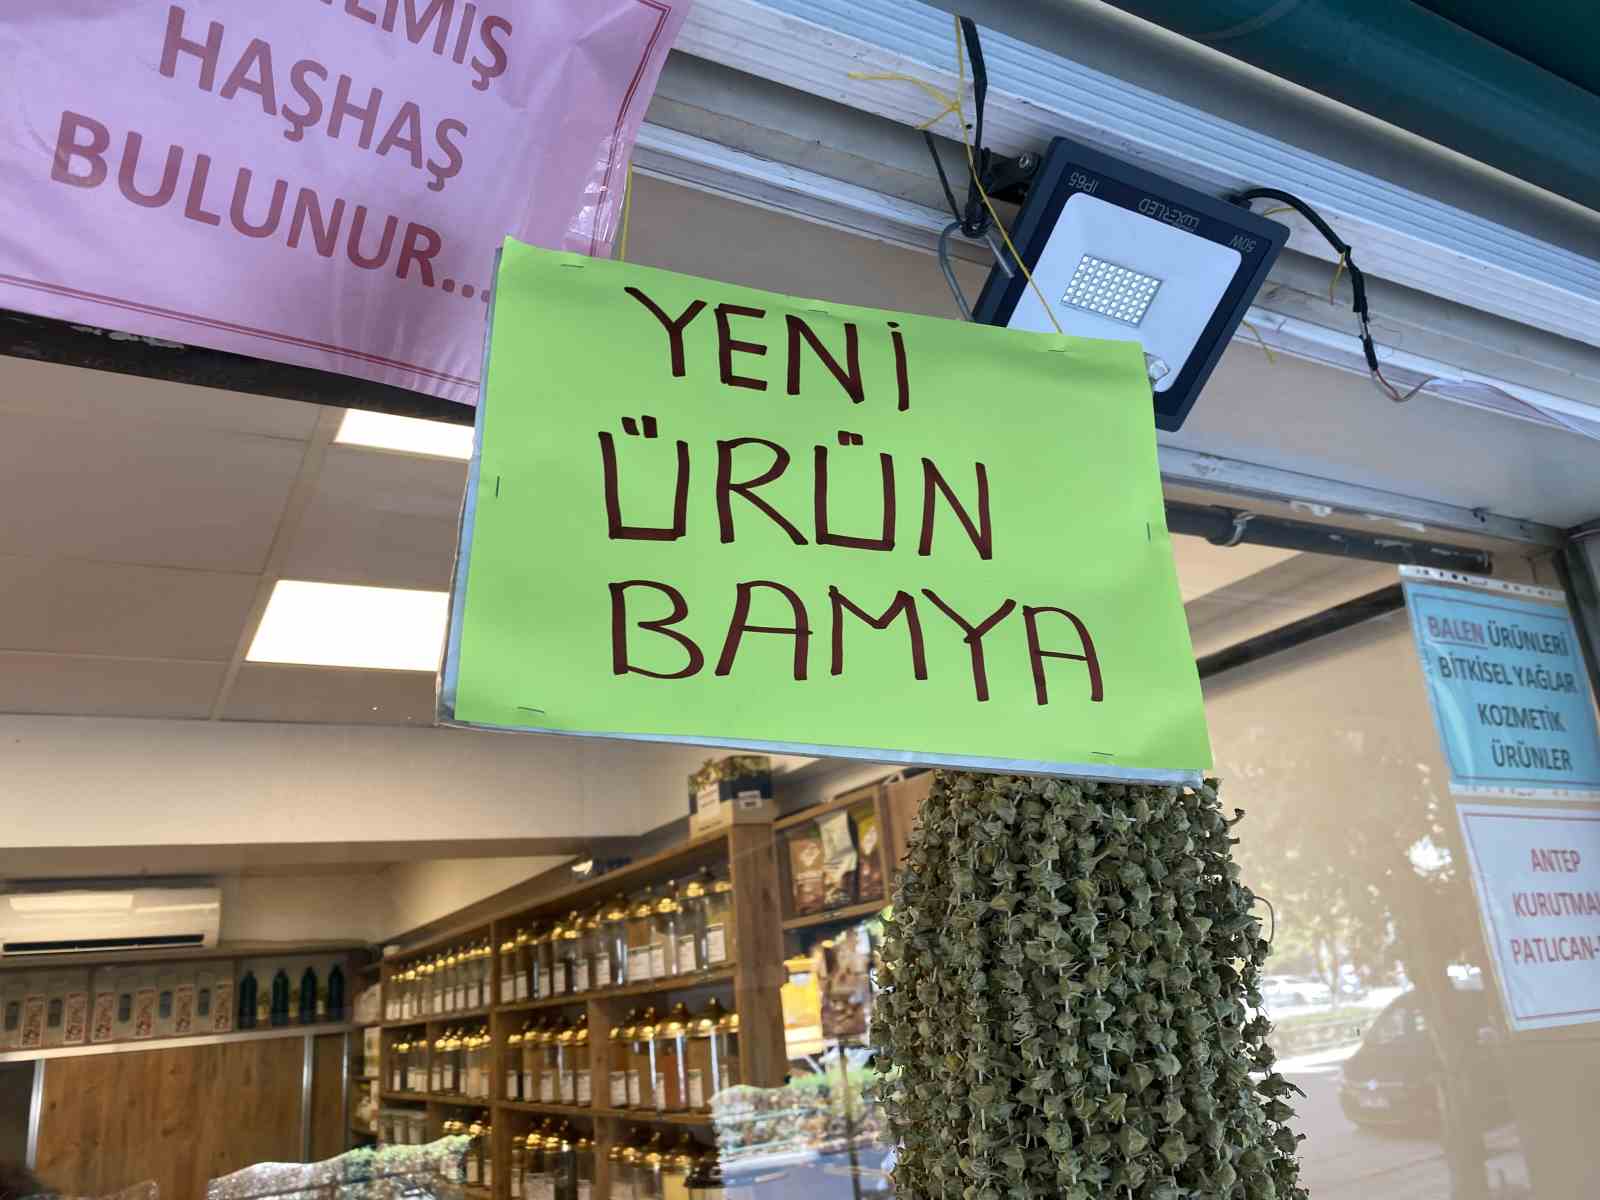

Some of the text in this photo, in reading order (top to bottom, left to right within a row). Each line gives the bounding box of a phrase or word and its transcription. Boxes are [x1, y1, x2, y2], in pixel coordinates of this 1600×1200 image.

[159, 6, 468, 192] HAŞHAŞ
[1068, 171, 1098, 193] IP65
[1229, 234, 1257, 252] 50W
[624, 286, 909, 411] YENİ
[598, 416, 992, 560] ÜRÜN
[608, 580, 1104, 705] BAMYA
[1427, 615, 1570, 656] BALEN ÜRÜNLERİ
[1438, 653, 1578, 694] BİTKİSEL YAĞLAR
[1477, 703, 1566, 732] KOZMETİK
[1491, 739, 1573, 771] ÜRÜNLER
[1530, 848, 1581, 873] ANTEP
